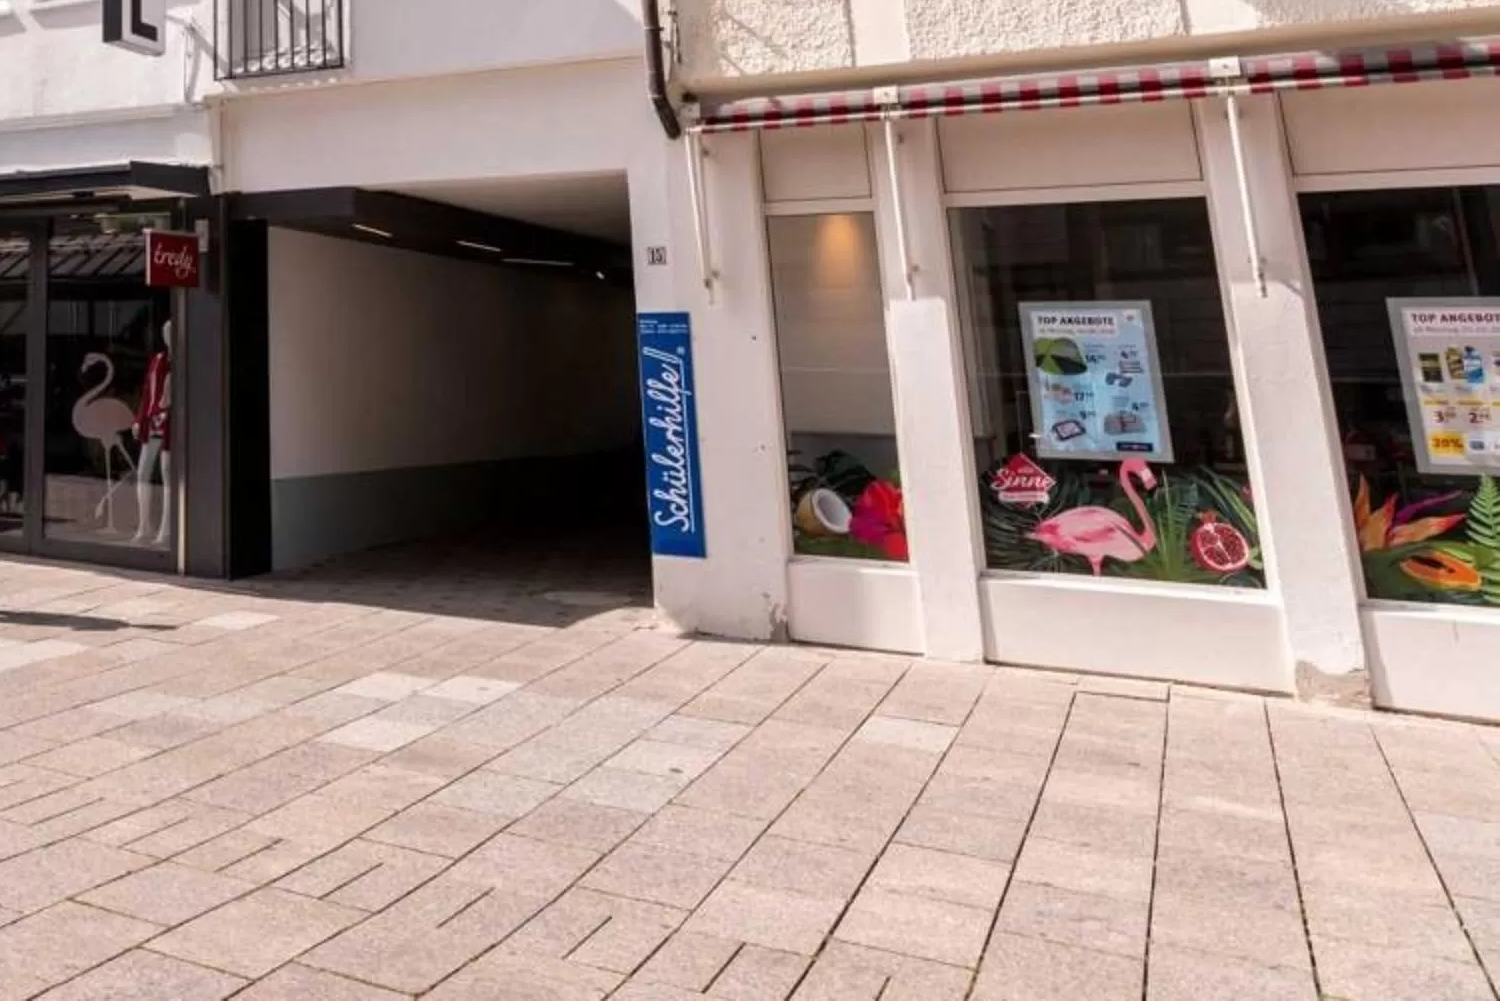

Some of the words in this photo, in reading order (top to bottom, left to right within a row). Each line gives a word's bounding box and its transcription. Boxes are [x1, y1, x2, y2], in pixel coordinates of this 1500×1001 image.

[153, 241, 197, 280] tredy
[1037, 316, 1058, 326] TOP
[1411, 312, 1436, 324] TOP
[642, 345, 693, 533] Schülerhilfe!
